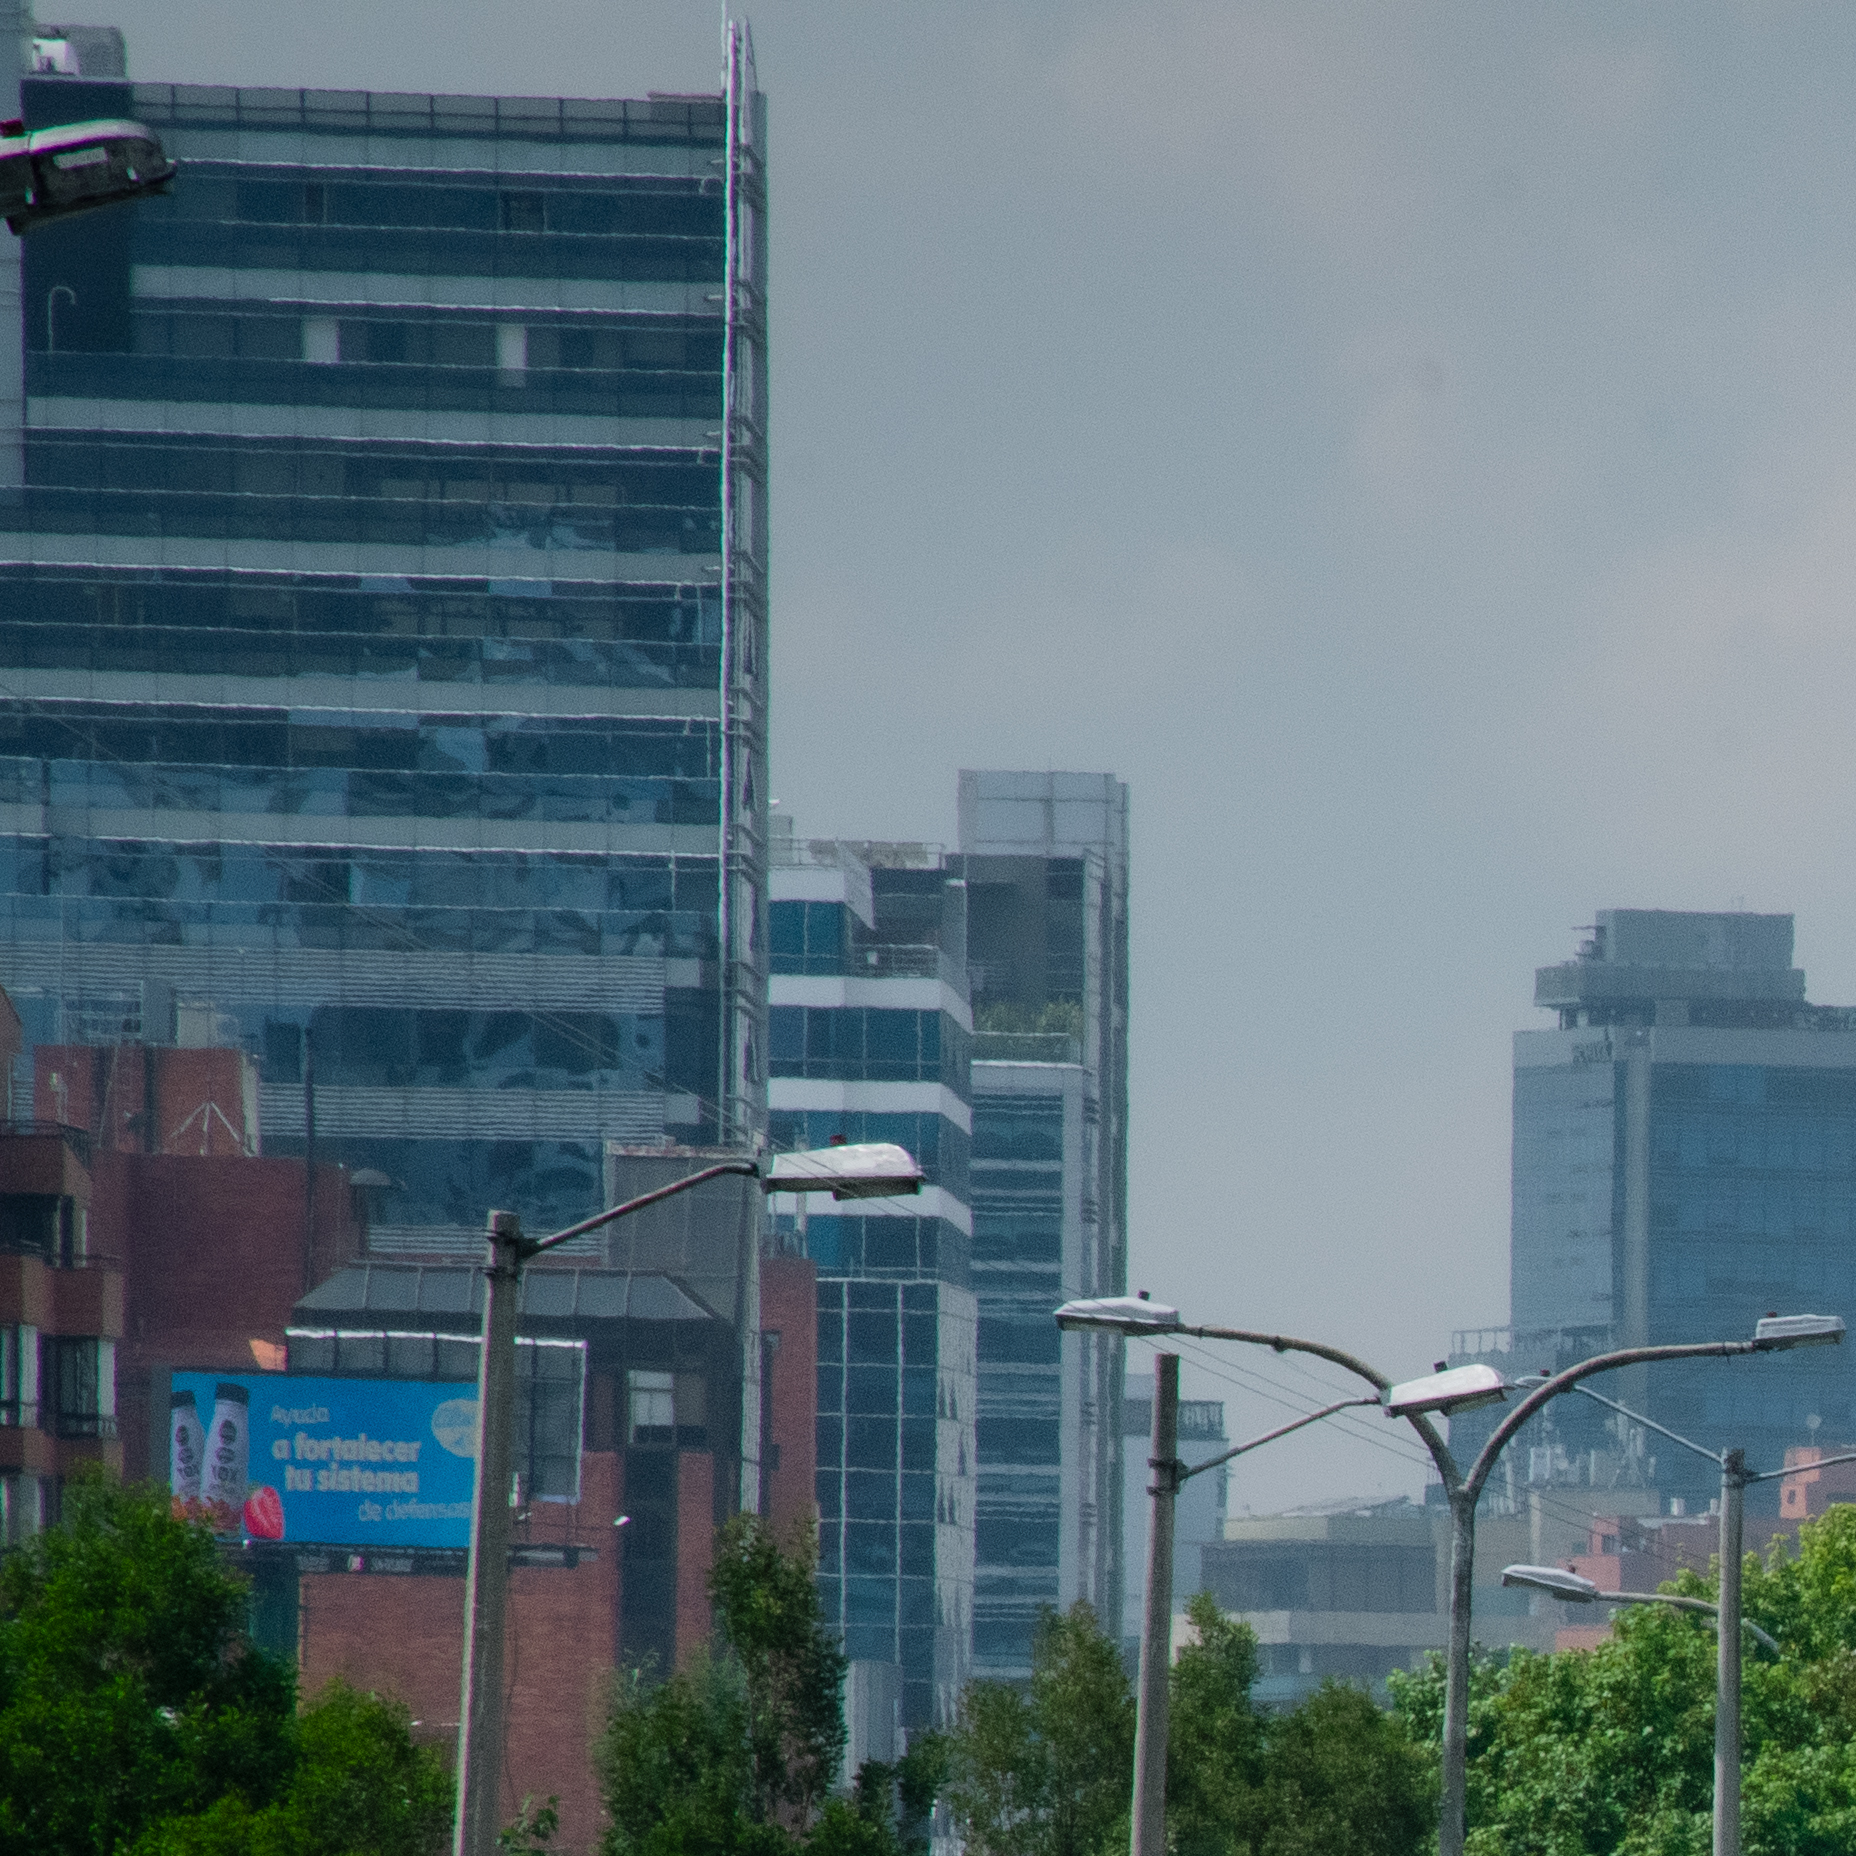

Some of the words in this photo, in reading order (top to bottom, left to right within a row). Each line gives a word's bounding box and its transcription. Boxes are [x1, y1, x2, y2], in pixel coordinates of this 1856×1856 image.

[270, 1403, 330, 1426] Ayuda
[271, 1438, 290, 1461] a
[294, 1431, 422, 1462] fortalecer
[285, 1464, 313, 1491] tu
[316, 1462, 420, 1493] sistema
[358, 1500, 382, 1522] de
